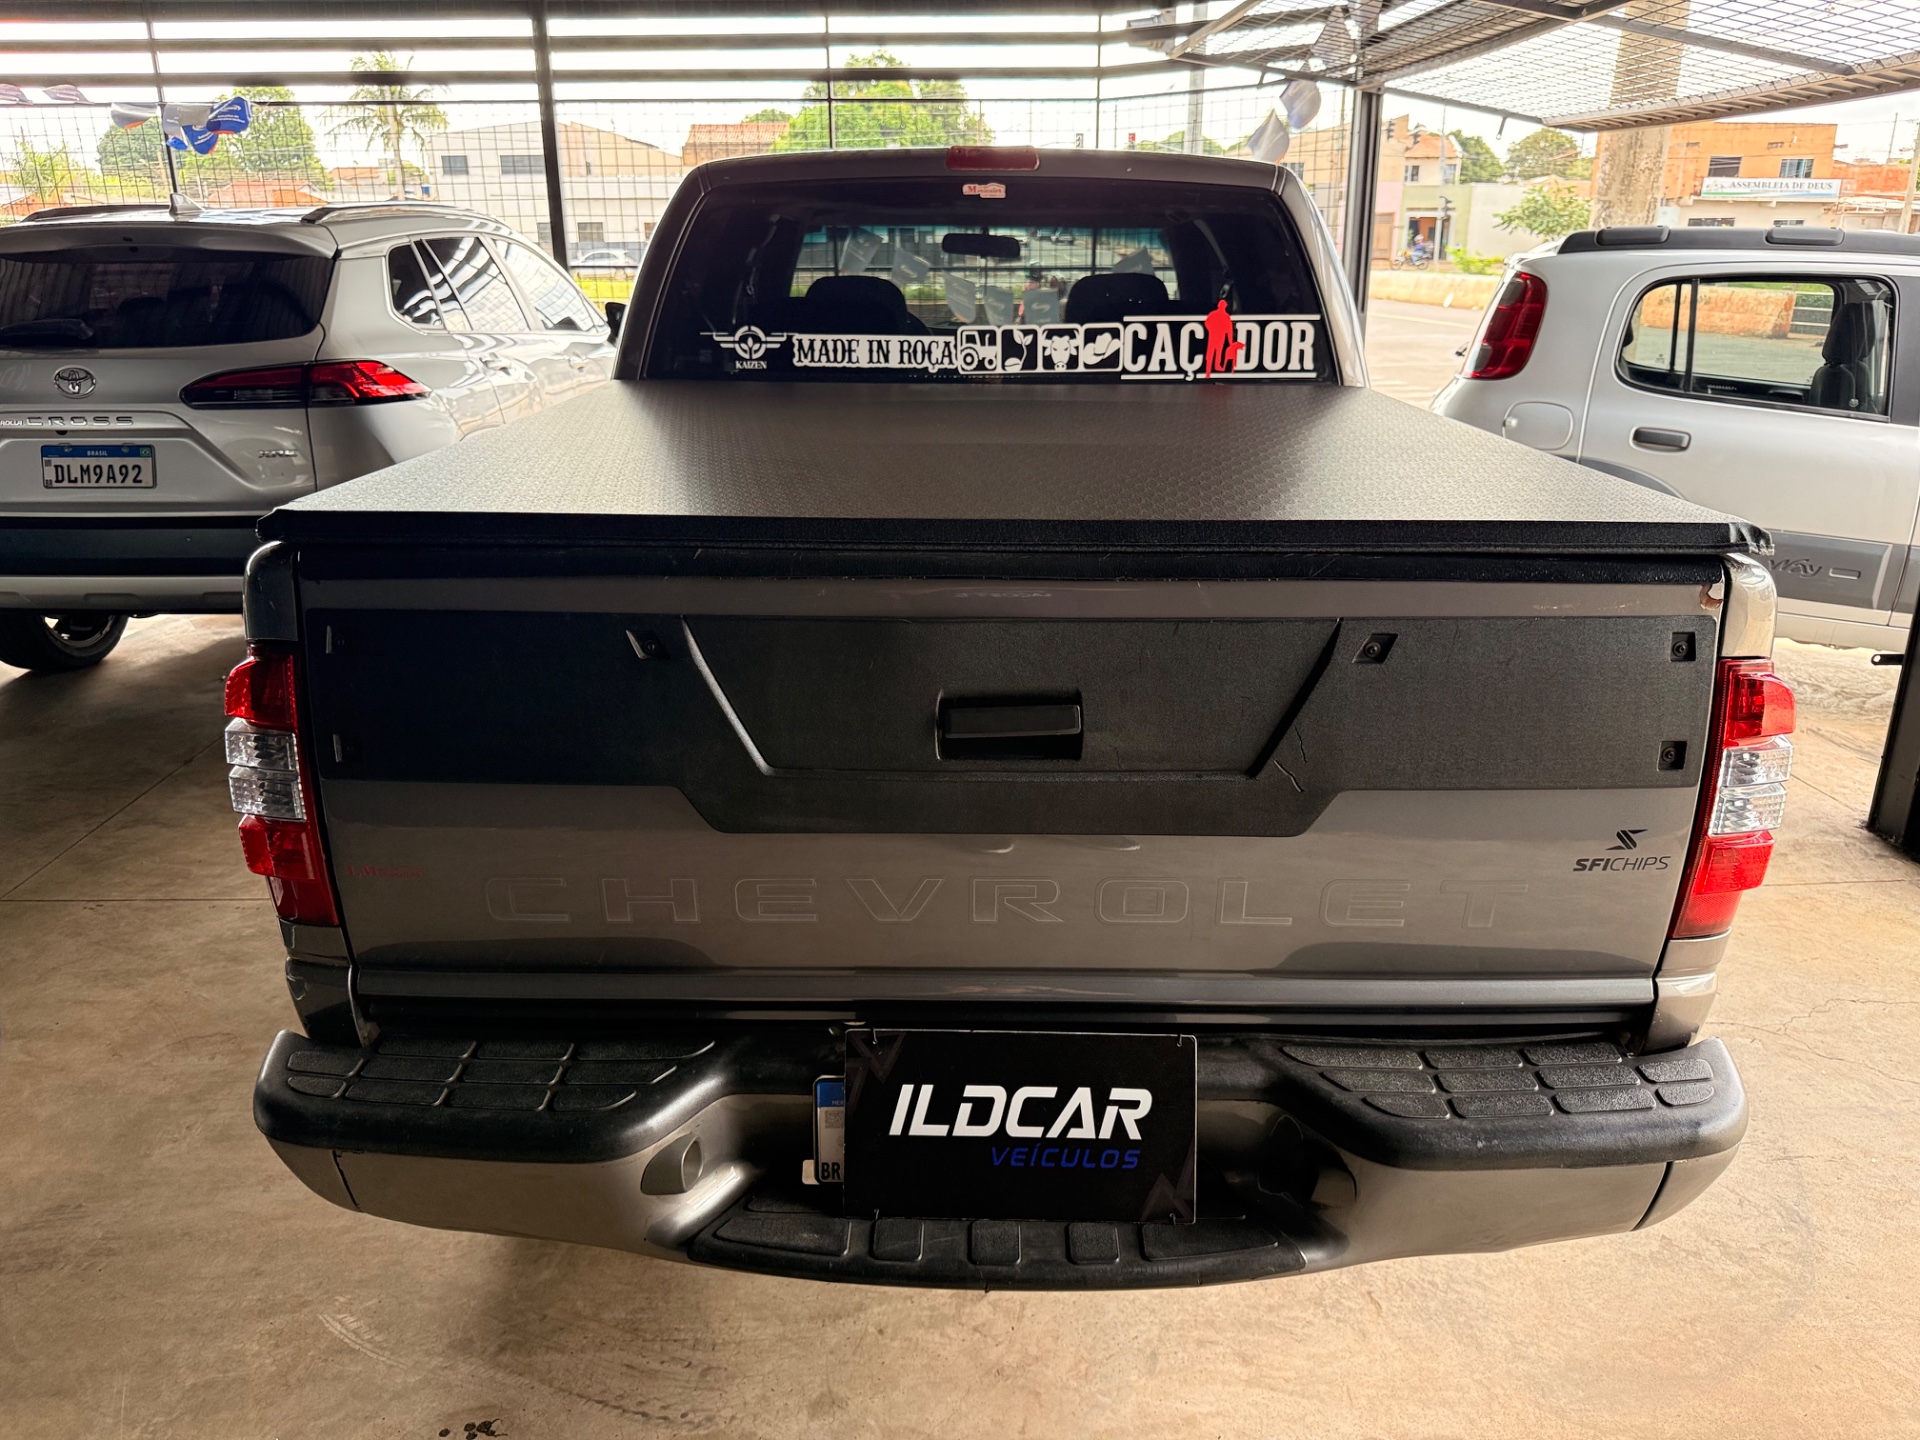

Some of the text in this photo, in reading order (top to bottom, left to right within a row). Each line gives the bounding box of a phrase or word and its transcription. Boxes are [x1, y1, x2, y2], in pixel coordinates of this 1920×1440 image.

[1730, 181, 1833, 190] ASSEMBLEIA DE DEUS
[795, 338, 955, 370] MADE IN ROÇA
[1123, 321, 1315, 381] CAÇDOR
[735, 360, 767, 370] KAIZEN
[26, 416, 134, 426] CROSS
[53, 464, 143, 484] DLM9A92
[484, 876, 1528, 928] CHEVROLET
[889, 1084, 1153, 1140] ILDCAR
[990, 1143, 1141, 1169] VEÍCULOS
[821, 1162, 842, 1180] BR
